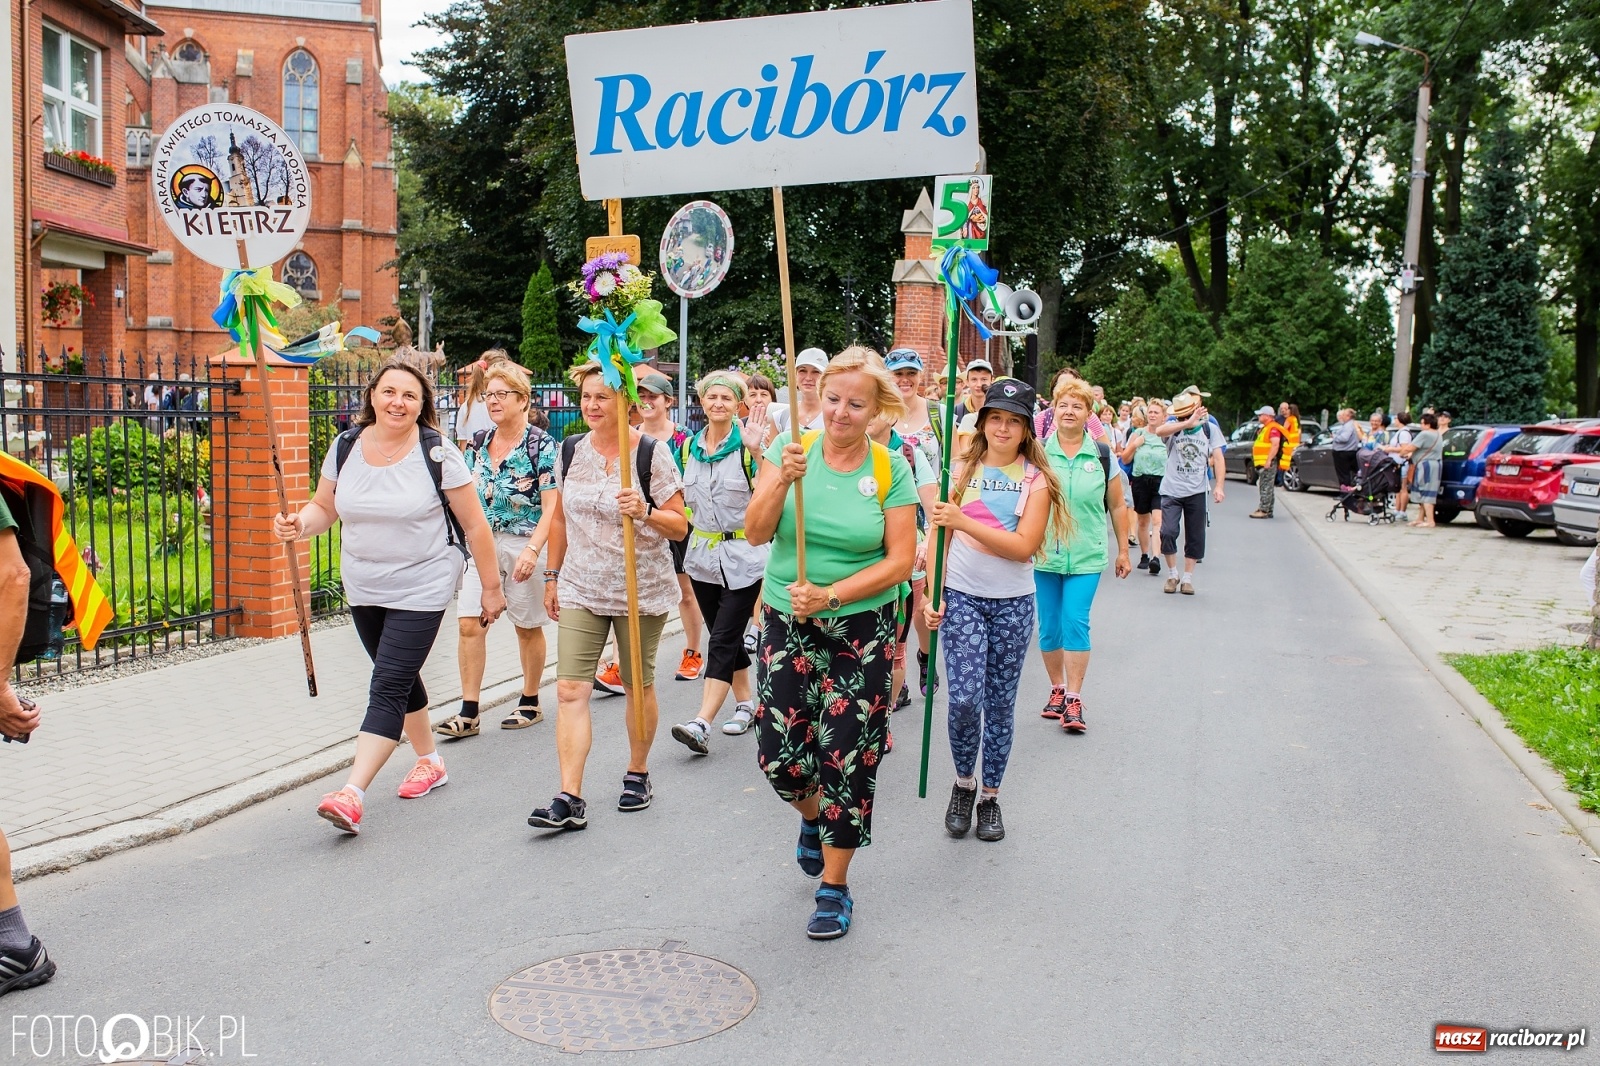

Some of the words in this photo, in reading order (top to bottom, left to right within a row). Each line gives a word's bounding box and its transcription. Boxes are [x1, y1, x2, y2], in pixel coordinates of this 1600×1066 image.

[589, 50, 967, 155] Racibórz
[160, 112, 212, 157] ŚWIĘTEGO
[214, 111, 278, 144] TOMASZA
[156, 159, 173, 215] PARAFIA
[277, 143, 307, 209] APOSTOŁA
[182, 209, 295, 236] KIETRZ
[937, 181, 970, 237] 5
[630, 245, 637, 257] 5
[982, 478, 1025, 493] YEAH
